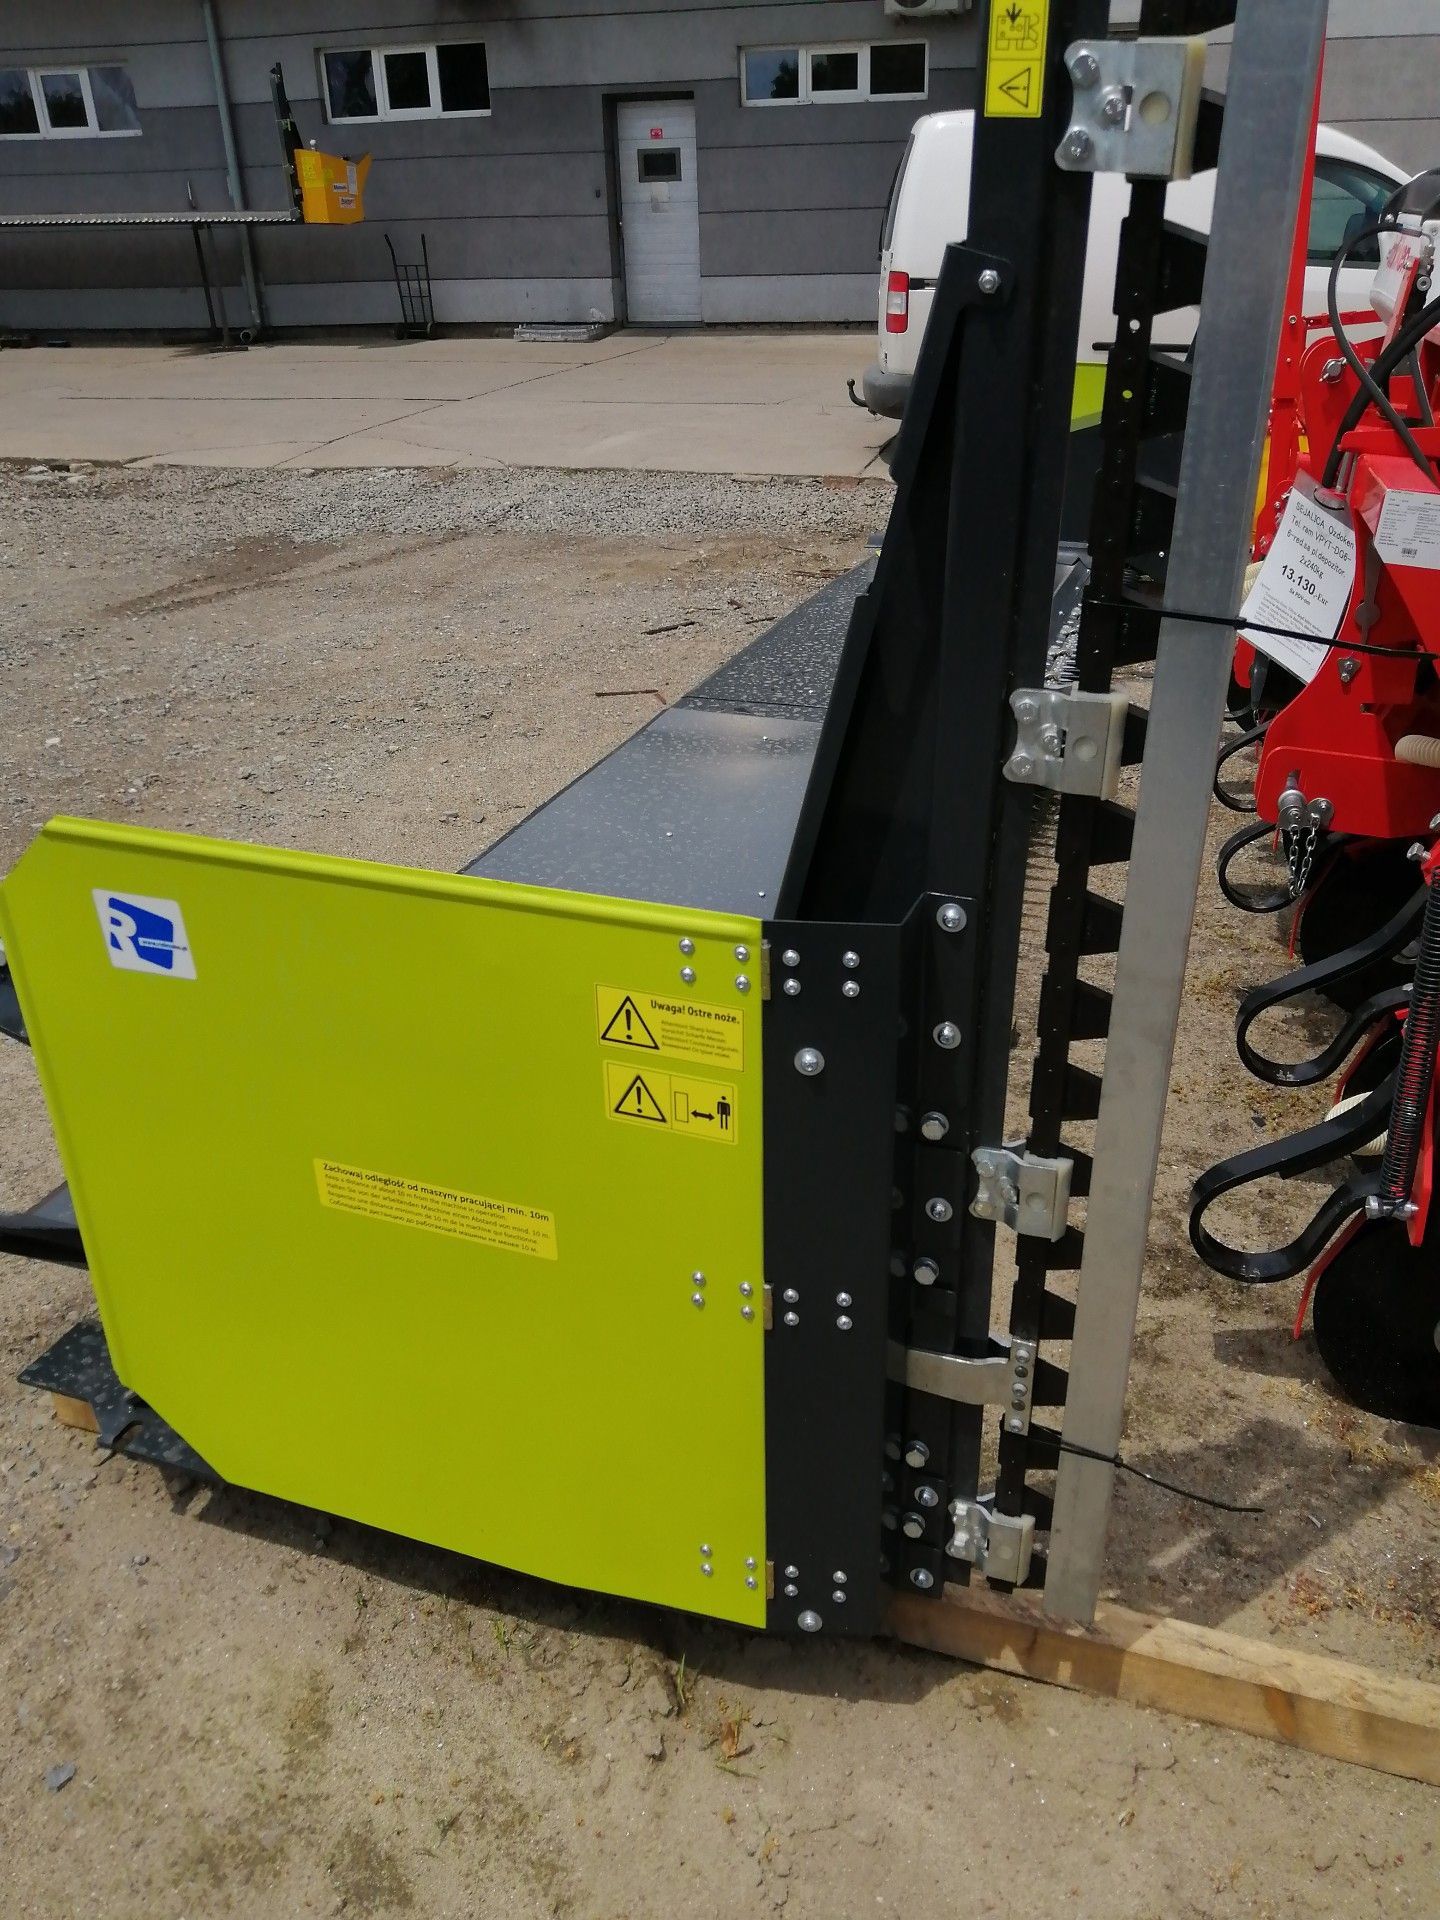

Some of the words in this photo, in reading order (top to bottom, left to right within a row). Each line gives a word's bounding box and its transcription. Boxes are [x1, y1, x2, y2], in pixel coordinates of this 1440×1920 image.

[1296, 501, 1325, 529] SEJALICA
[1328, 526, 1354, 549] Ozdoken
[1299, 555, 1324, 579] 2x240kg
[651, 1000, 685, 1015] Uwaga!
[688, 1006, 712, 1018] Ostre
[714, 1011, 740, 1024] noże.
[323, 1164, 362, 1179] Zachowaj
[365, 1174, 405, 1189] odległość
[407, 1183, 418, 1192] od
[420, 1186, 457, 1201] maszyny
[460, 1196, 505, 1212] pracującej
[507, 1206, 527, 1217] min.
[530, 1211, 549, 1222] 10m
